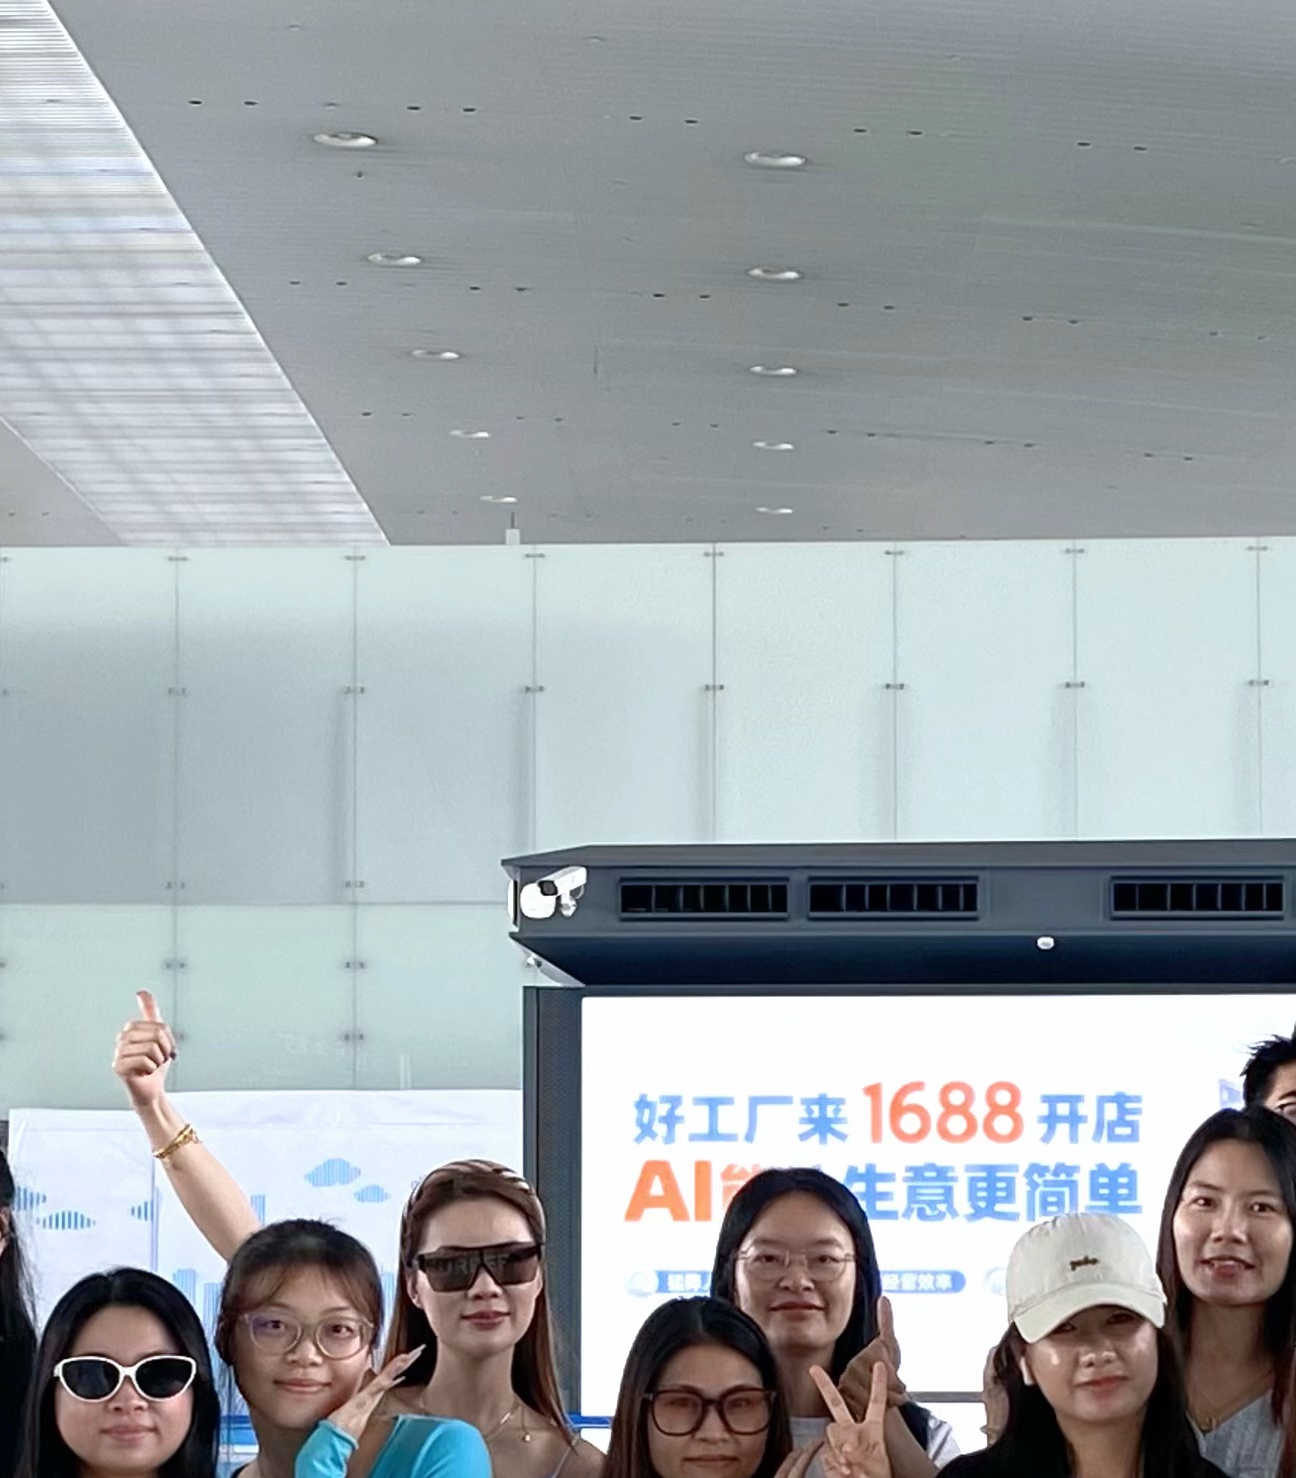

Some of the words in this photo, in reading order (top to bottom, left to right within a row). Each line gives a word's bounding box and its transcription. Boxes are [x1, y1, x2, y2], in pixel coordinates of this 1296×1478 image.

[633, 1092, 848, 1145] 好工厂来
[862, 1080, 1025, 1144] 1688
[1037, 1091, 1143, 1144] 开店
[623, 1158, 1143, 1223] AI生意更简单
